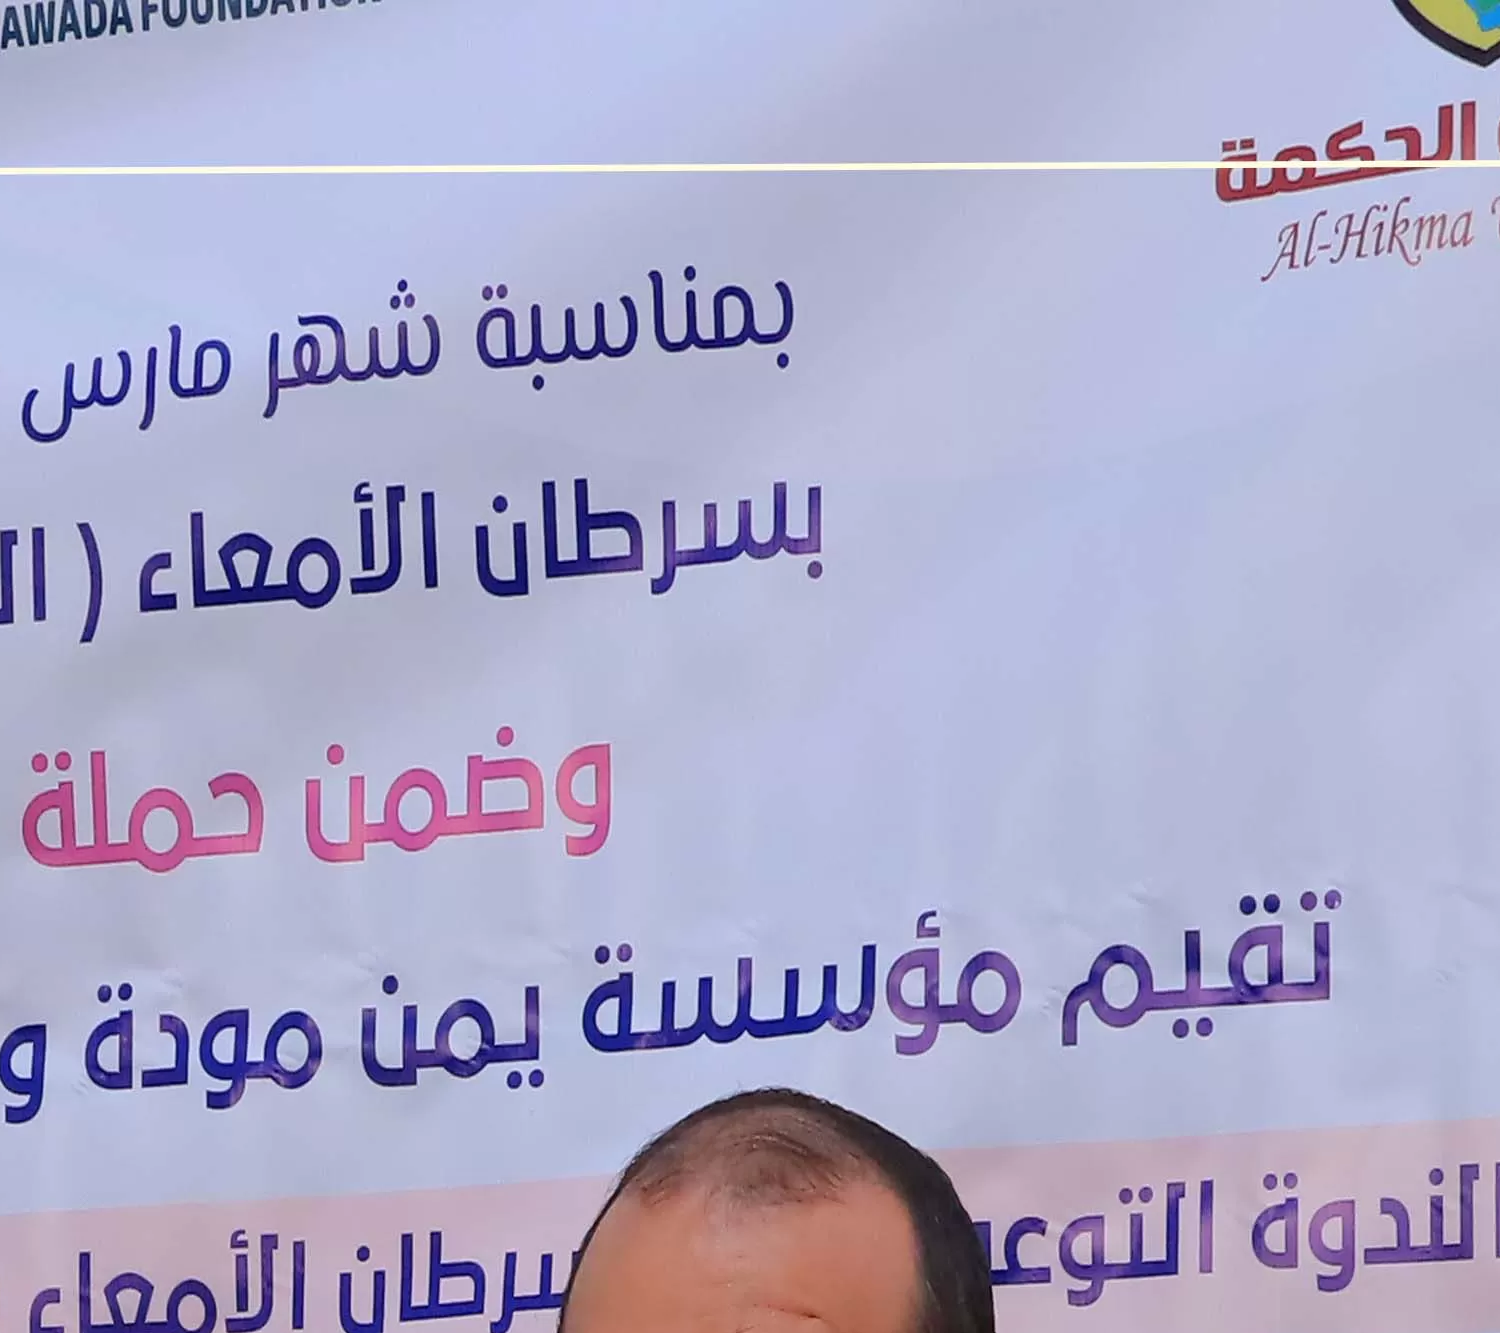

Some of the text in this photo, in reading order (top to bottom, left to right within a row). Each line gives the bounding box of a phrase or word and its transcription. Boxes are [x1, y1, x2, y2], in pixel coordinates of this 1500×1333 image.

[1214, 100, 1478, 203] الحكمة
[1259, 196, 1474, 284] Al-Hikma
[21, 324, 232, 445] مارس
[262, 278, 442, 420] شهر
[475, 265, 796, 391] بمناسبة
[138, 480, 439, 612] الأمعاء
[474, 477, 825, 598] بسرطان
[21, 750, 265, 875] حملة
[304, 725, 614, 863] وضمن
[580, 909, 1023, 1057] مؤسسة
[1061, 888, 1344, 1047] تقيم
[83, 983, 324, 1112] مودة
[360, 974, 546, 1090] يمن
